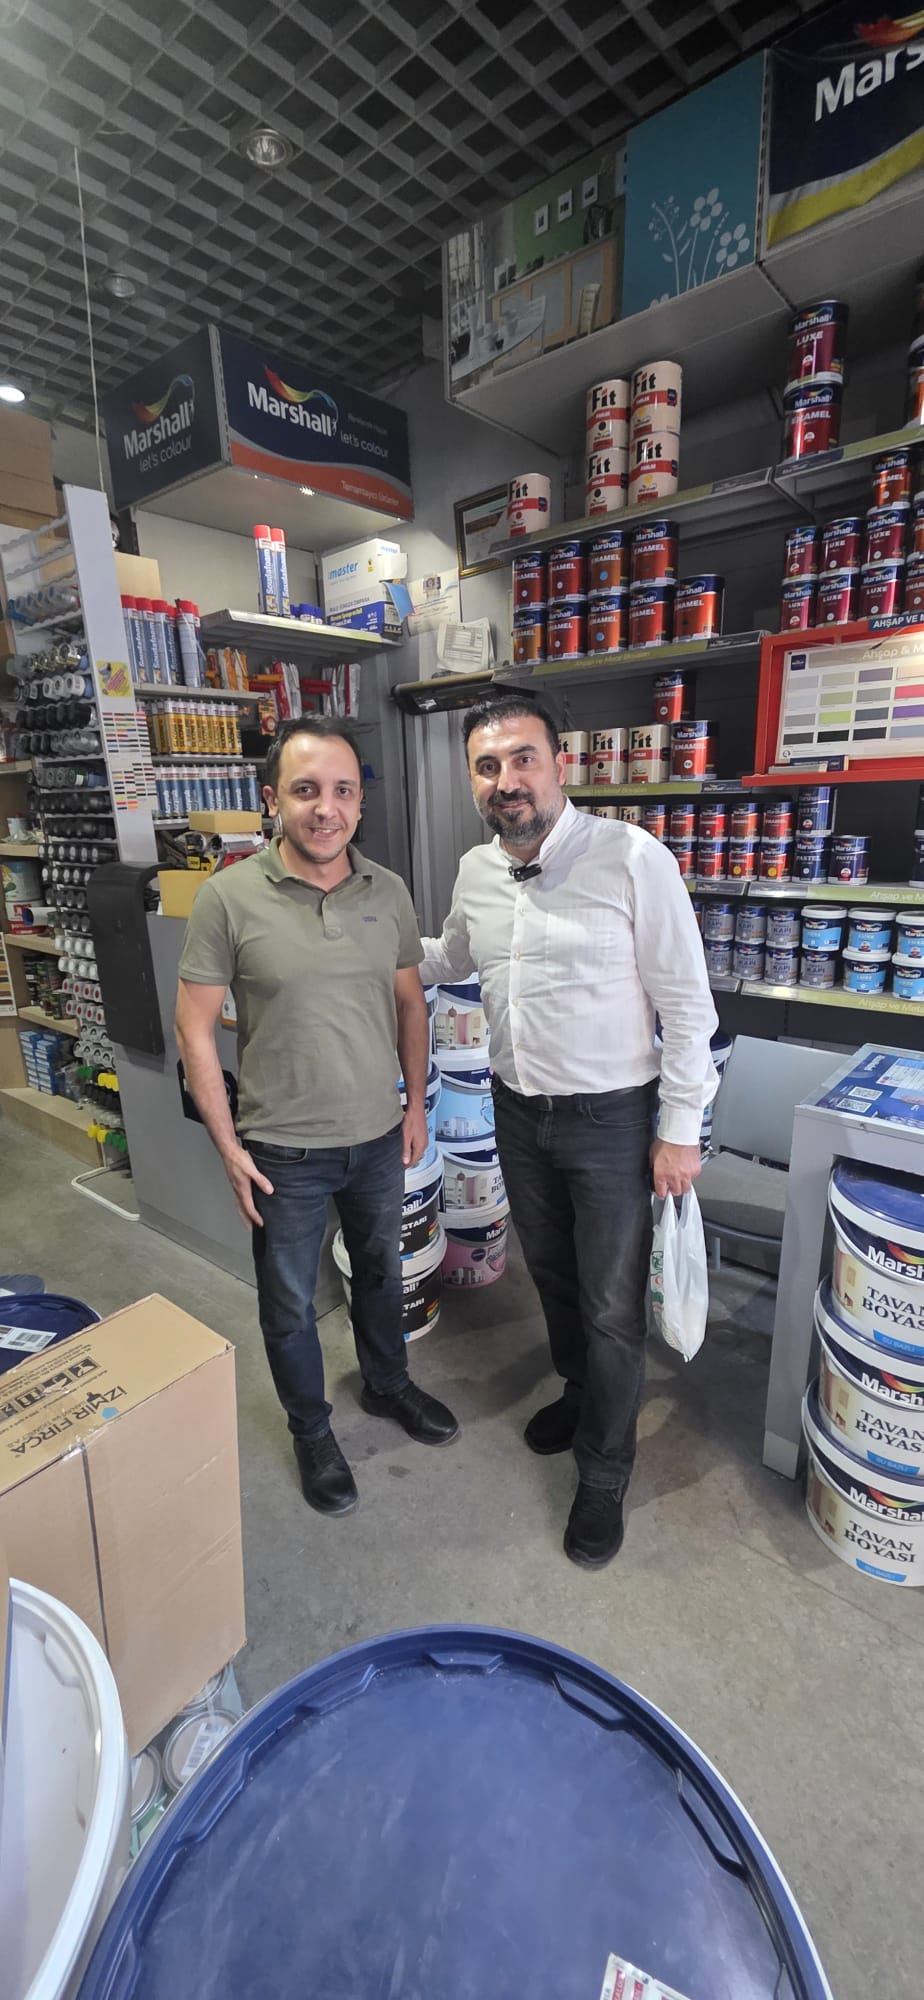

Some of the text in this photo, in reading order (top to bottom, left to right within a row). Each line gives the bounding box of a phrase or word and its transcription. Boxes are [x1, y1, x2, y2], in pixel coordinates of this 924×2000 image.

[815, 44, 924, 122] Mars
[794, 314, 832, 331] Marshall
[796, 331, 824, 346] LUXE
[633, 370, 656, 396] Fit
[591, 386, 616, 413] Fit
[794, 394, 832, 409] Marshall
[247, 381, 333, 437] Marshall
[792, 410, 831, 424] ENAMEL
[123, 401, 192, 459] Marshall
[160, 434, 193, 463] colour
[360, 439, 389, 458] colour
[636, 438, 662, 464] Fit
[588, 455, 610, 479] Fit
[875, 456, 907, 471] Marshall
[509, 480, 529, 498] Fit
[867, 516, 899, 530] Marshall
[636, 531, 665, 540] Marshall
[824, 526, 853, 539] Marshall
[869, 530, 891, 540] LUXE
[592, 540, 620, 551] Marshall
[634, 544, 666, 554] ENAMEL
[550, 551, 576, 560] Marshall
[592, 554, 620, 563] ENAMEL
[265, 549, 274, 594] Soudafoam
[863, 571, 895, 584] Marshall
[676, 586, 705, 598] Marshall
[821, 581, 849, 592] Marshall
[866, 585, 888, 595] LUXE
[629, 596, 657, 606] Marshall
[823, 593, 843, 602] LUXE
[590, 603, 618, 613] Marshall
[873, 617, 904, 629] AHŞAP
[905, 614, 918, 624] VE
[592, 733, 614, 751] Fit
[631, 731, 652, 750] Fit
[621, 808, 635, 821] Fit
[401, 1216, 428, 1231] STARI
[403, 1298, 424, 1310] TARI
[861, 1372, 924, 1406] Marsh
[861, 1409, 924, 1441] TAVAN
[849, 1520, 914, 1552] TAVAN
[843, 1527, 916, 1563] BOYASI
